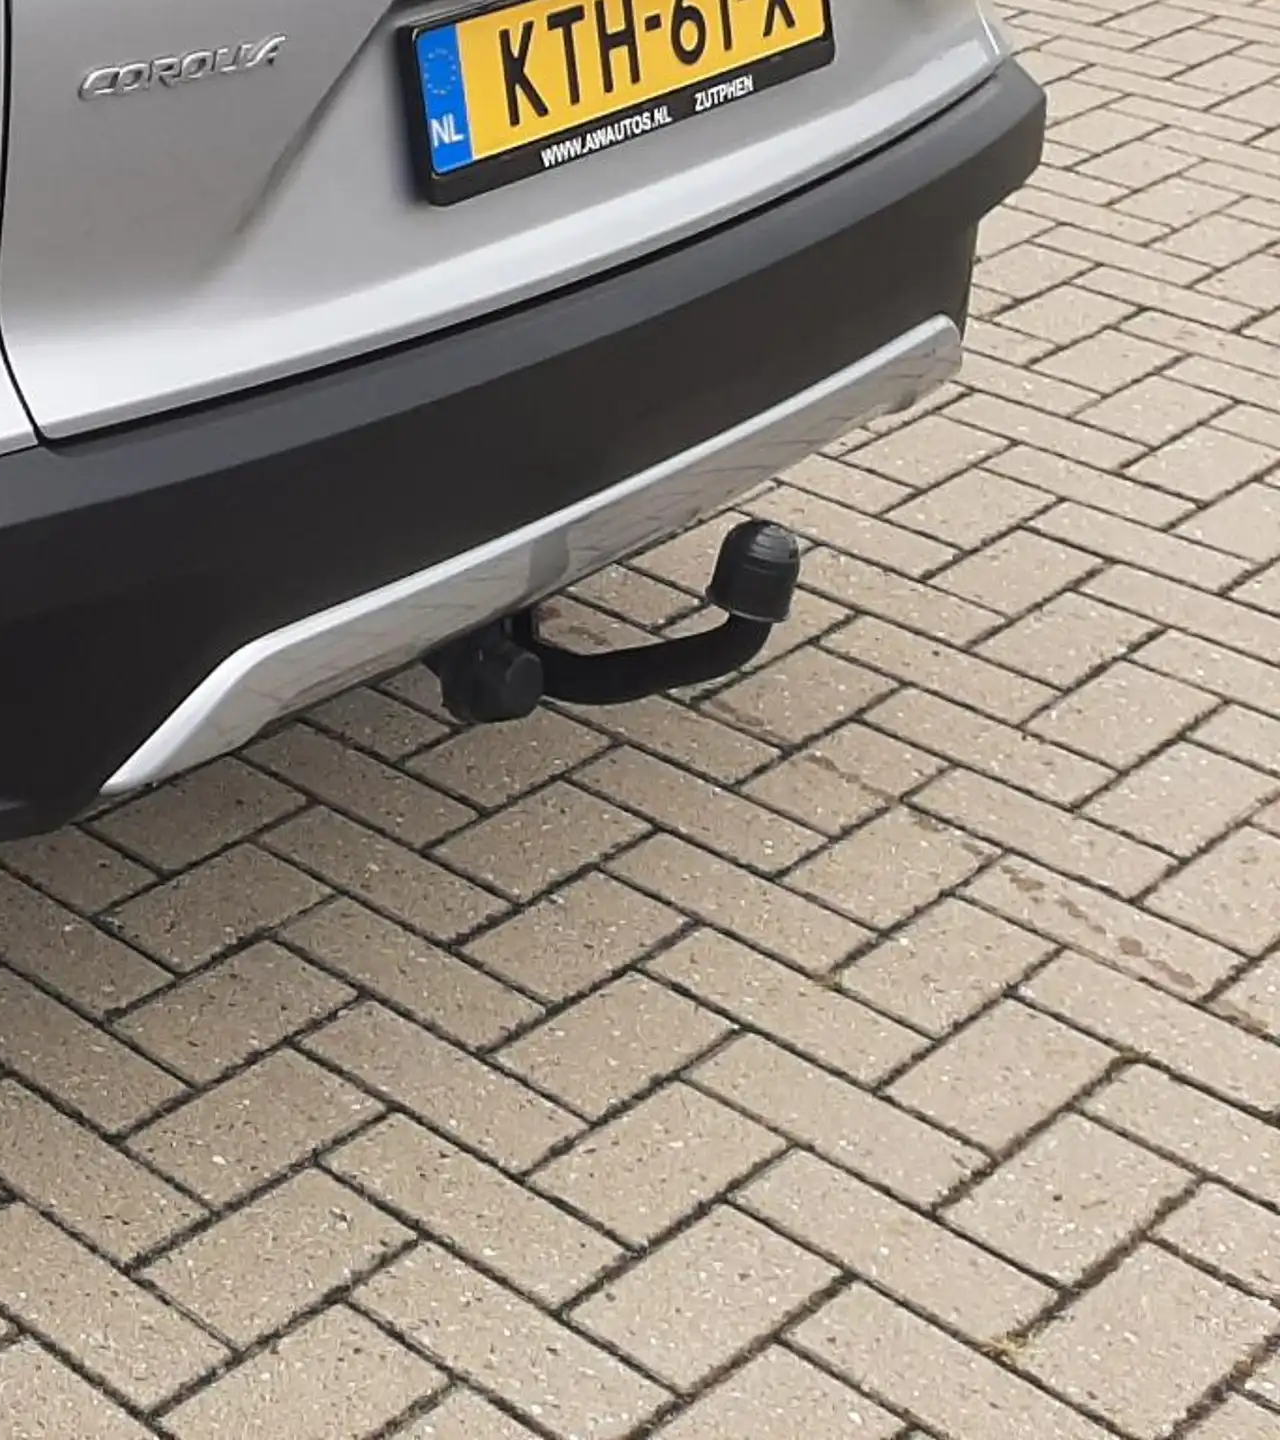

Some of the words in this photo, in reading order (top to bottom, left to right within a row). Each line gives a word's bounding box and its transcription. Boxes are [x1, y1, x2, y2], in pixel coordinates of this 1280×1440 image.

[78, 33, 287, 100] COROLLA
[430, 112, 464, 148] NL
[541, 105, 672, 168] WWW.AWAUTOS.NL
[694, 74, 754, 111] ZUTPHEN
